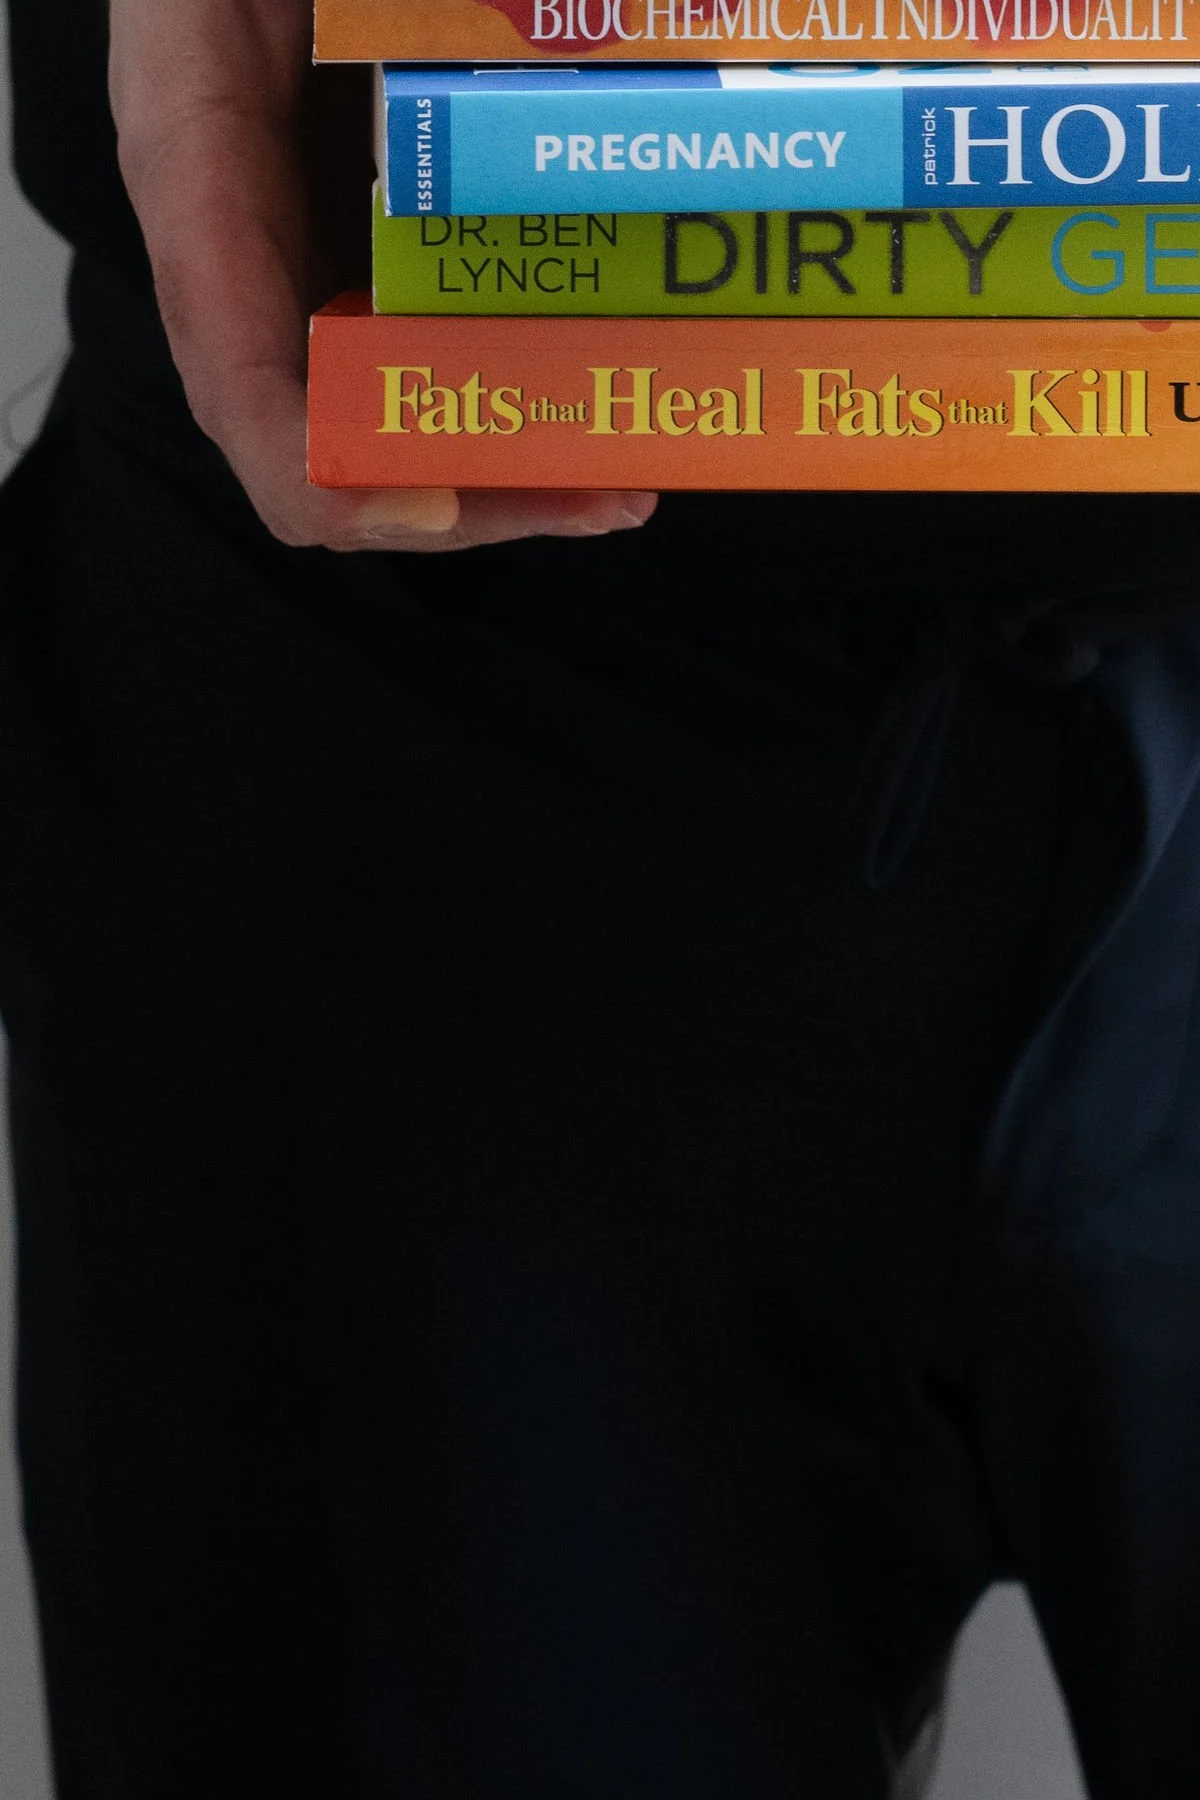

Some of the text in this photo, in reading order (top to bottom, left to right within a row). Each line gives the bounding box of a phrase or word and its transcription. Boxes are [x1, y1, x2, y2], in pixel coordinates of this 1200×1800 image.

[417, 98, 432, 210] ESSENTIALS
[534, 131, 847, 172] PREGNANCY
[921, 107, 939, 185] patrick
[420, 214, 617, 246] DR. BEN
[665, 211, 1013, 295] DIRTY
[438, 257, 600, 293] LYNCH
[375, 366, 1152, 438] Fats that Heal Fats that Kill
